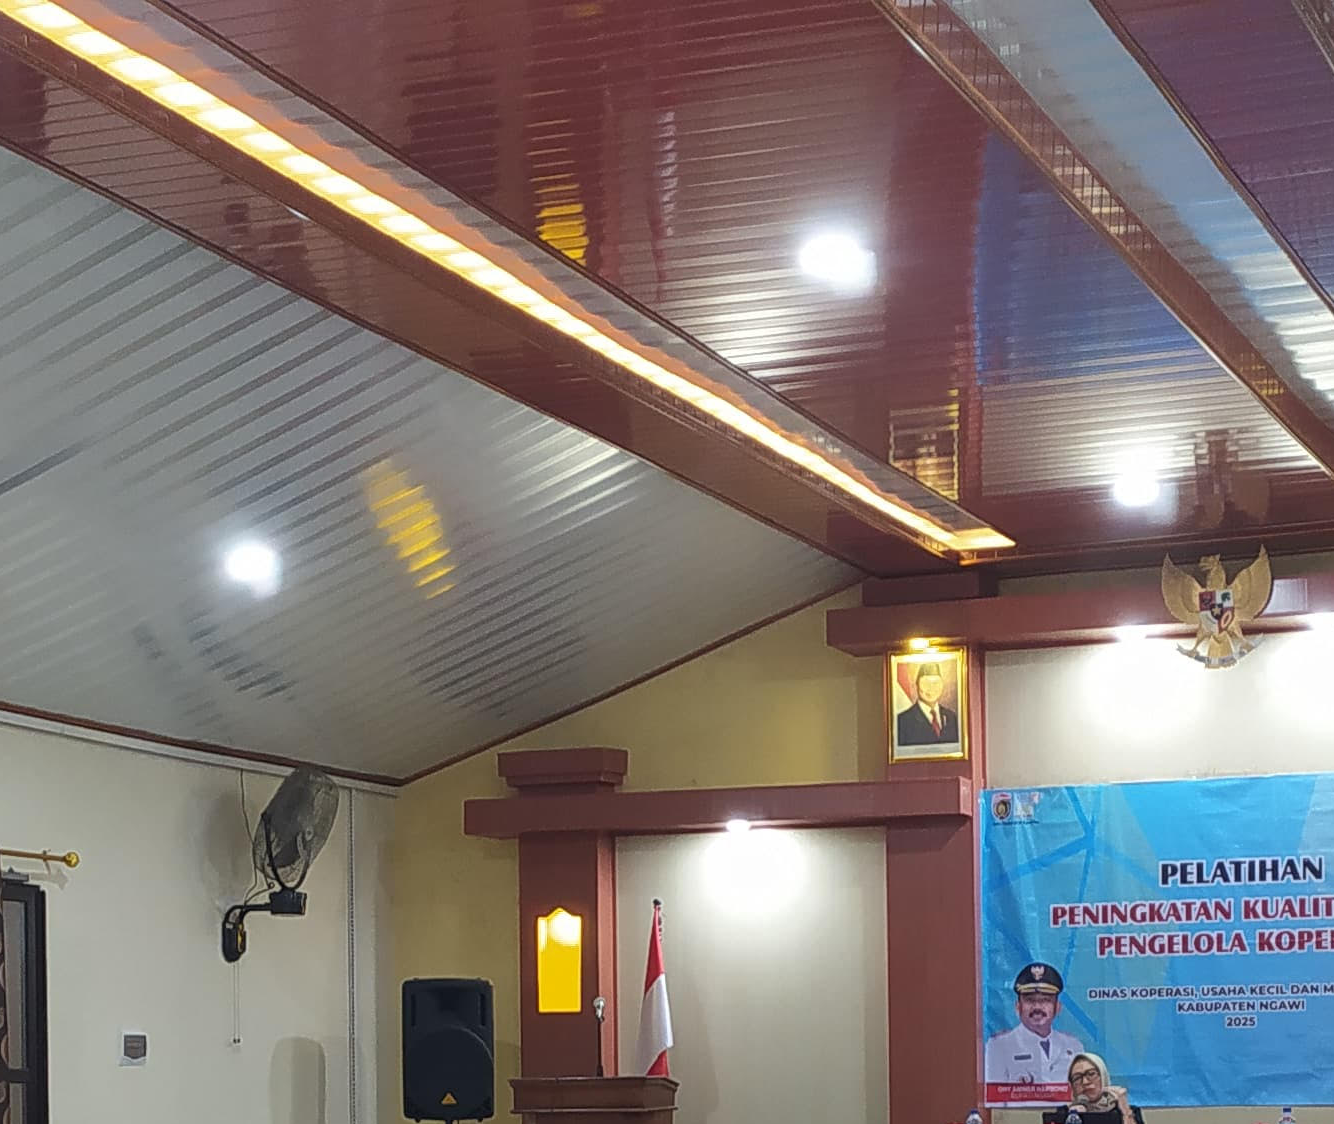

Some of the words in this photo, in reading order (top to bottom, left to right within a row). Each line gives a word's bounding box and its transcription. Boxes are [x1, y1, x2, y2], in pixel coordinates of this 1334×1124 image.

[1160, 856, 1324, 886] PELATIHAN
[1051, 900, 1232, 926] PENINGKATAN
[1098, 932, 1248, 956] PENGELOLA
[1088, 988, 1128, 999] DINAS
[1130, 987, 1198, 999] KOPERASI,
[1201, 986, 1246, 997] USAHA
[1249, 985, 1287, 996] KECIL
[1290, 983, 1320, 995] DAN
[1177, 1001, 1256, 1012] KABUPATEN
[1259, 1000, 1305, 1011] NGAWI
[1226, 1016, 1256, 1027] 2025
